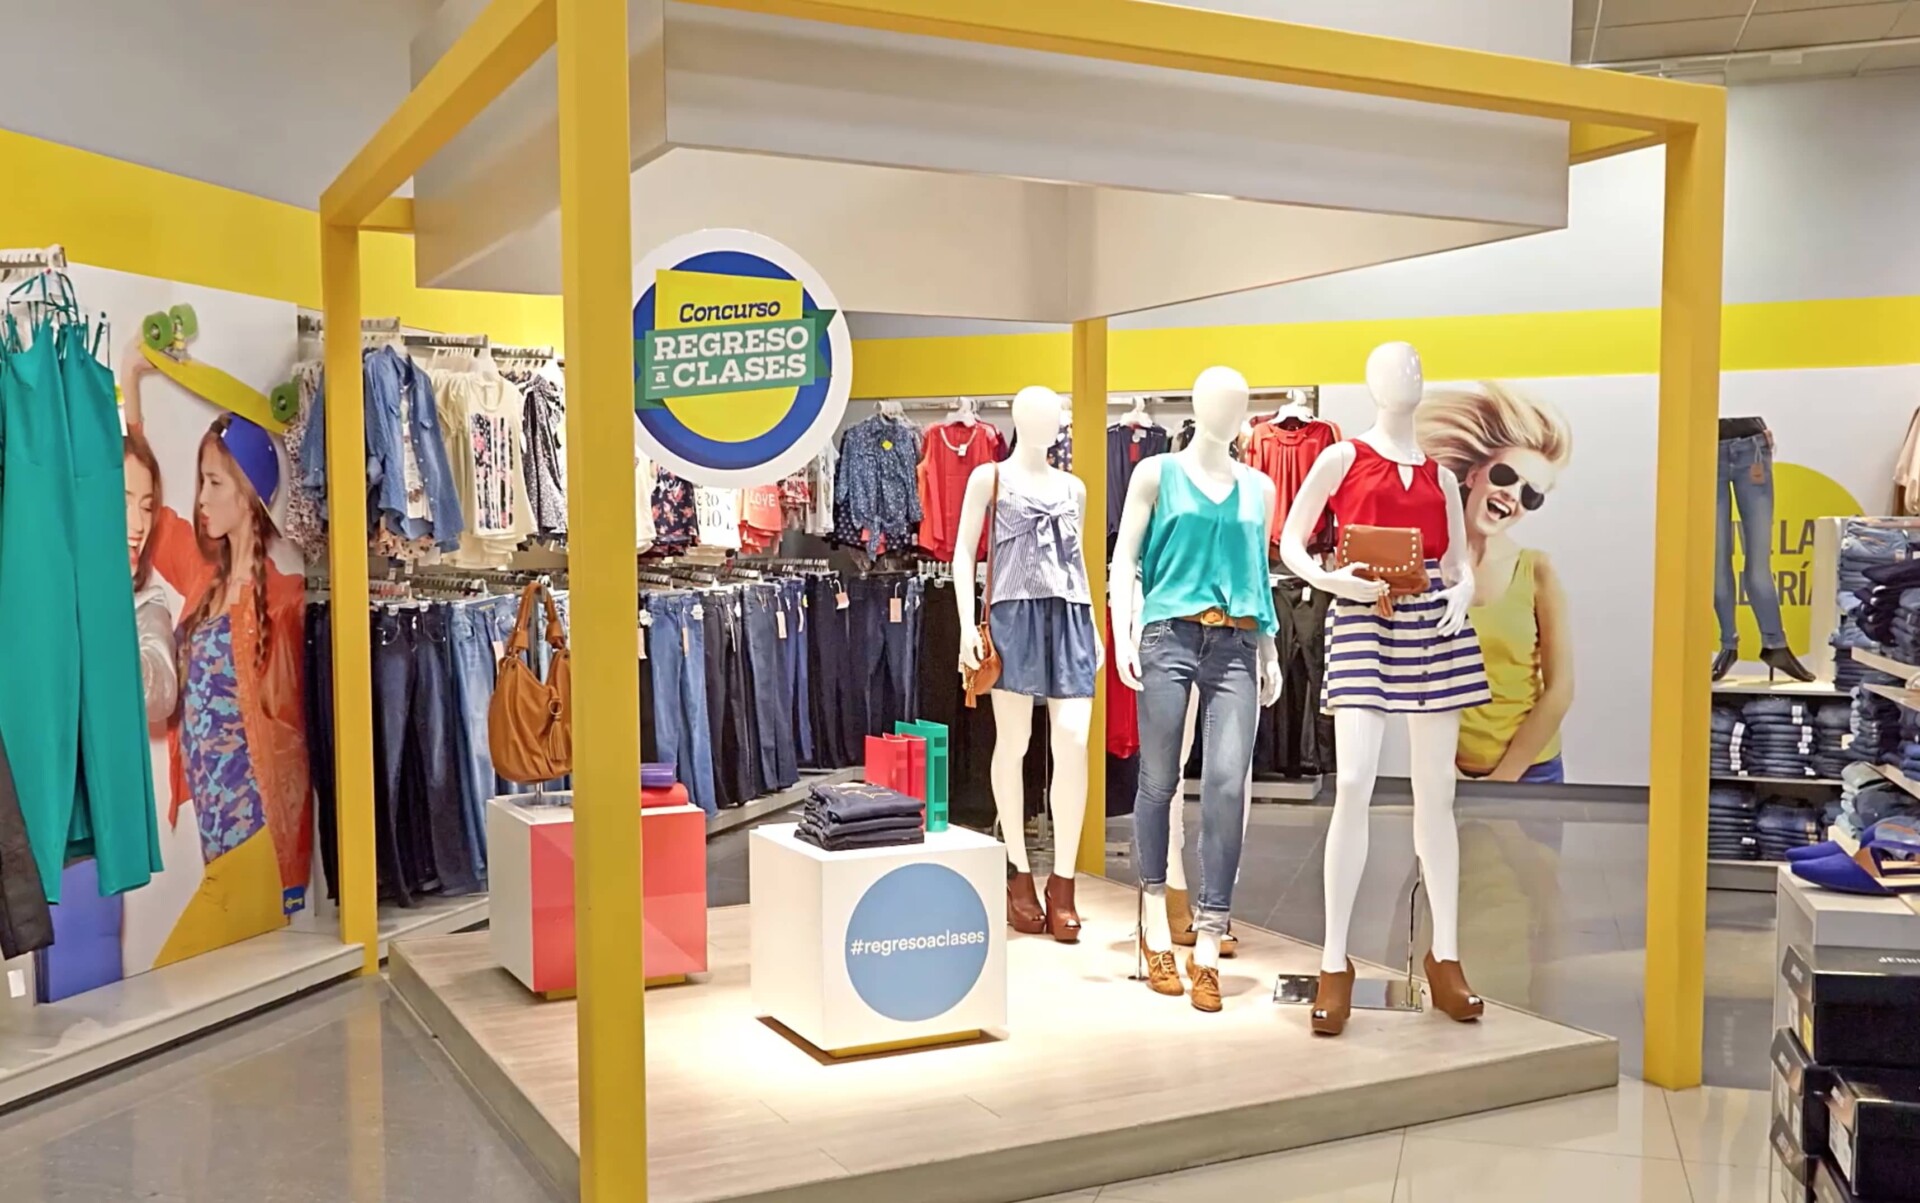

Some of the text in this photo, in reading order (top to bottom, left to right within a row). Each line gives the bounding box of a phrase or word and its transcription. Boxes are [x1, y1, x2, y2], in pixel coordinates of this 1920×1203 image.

[679, 301, 781, 323] Concurso
[654, 326, 809, 361] REGRESO
[655, 354, 807, 386] a CLASES
[850, 929, 985, 956] #regresoaclases
